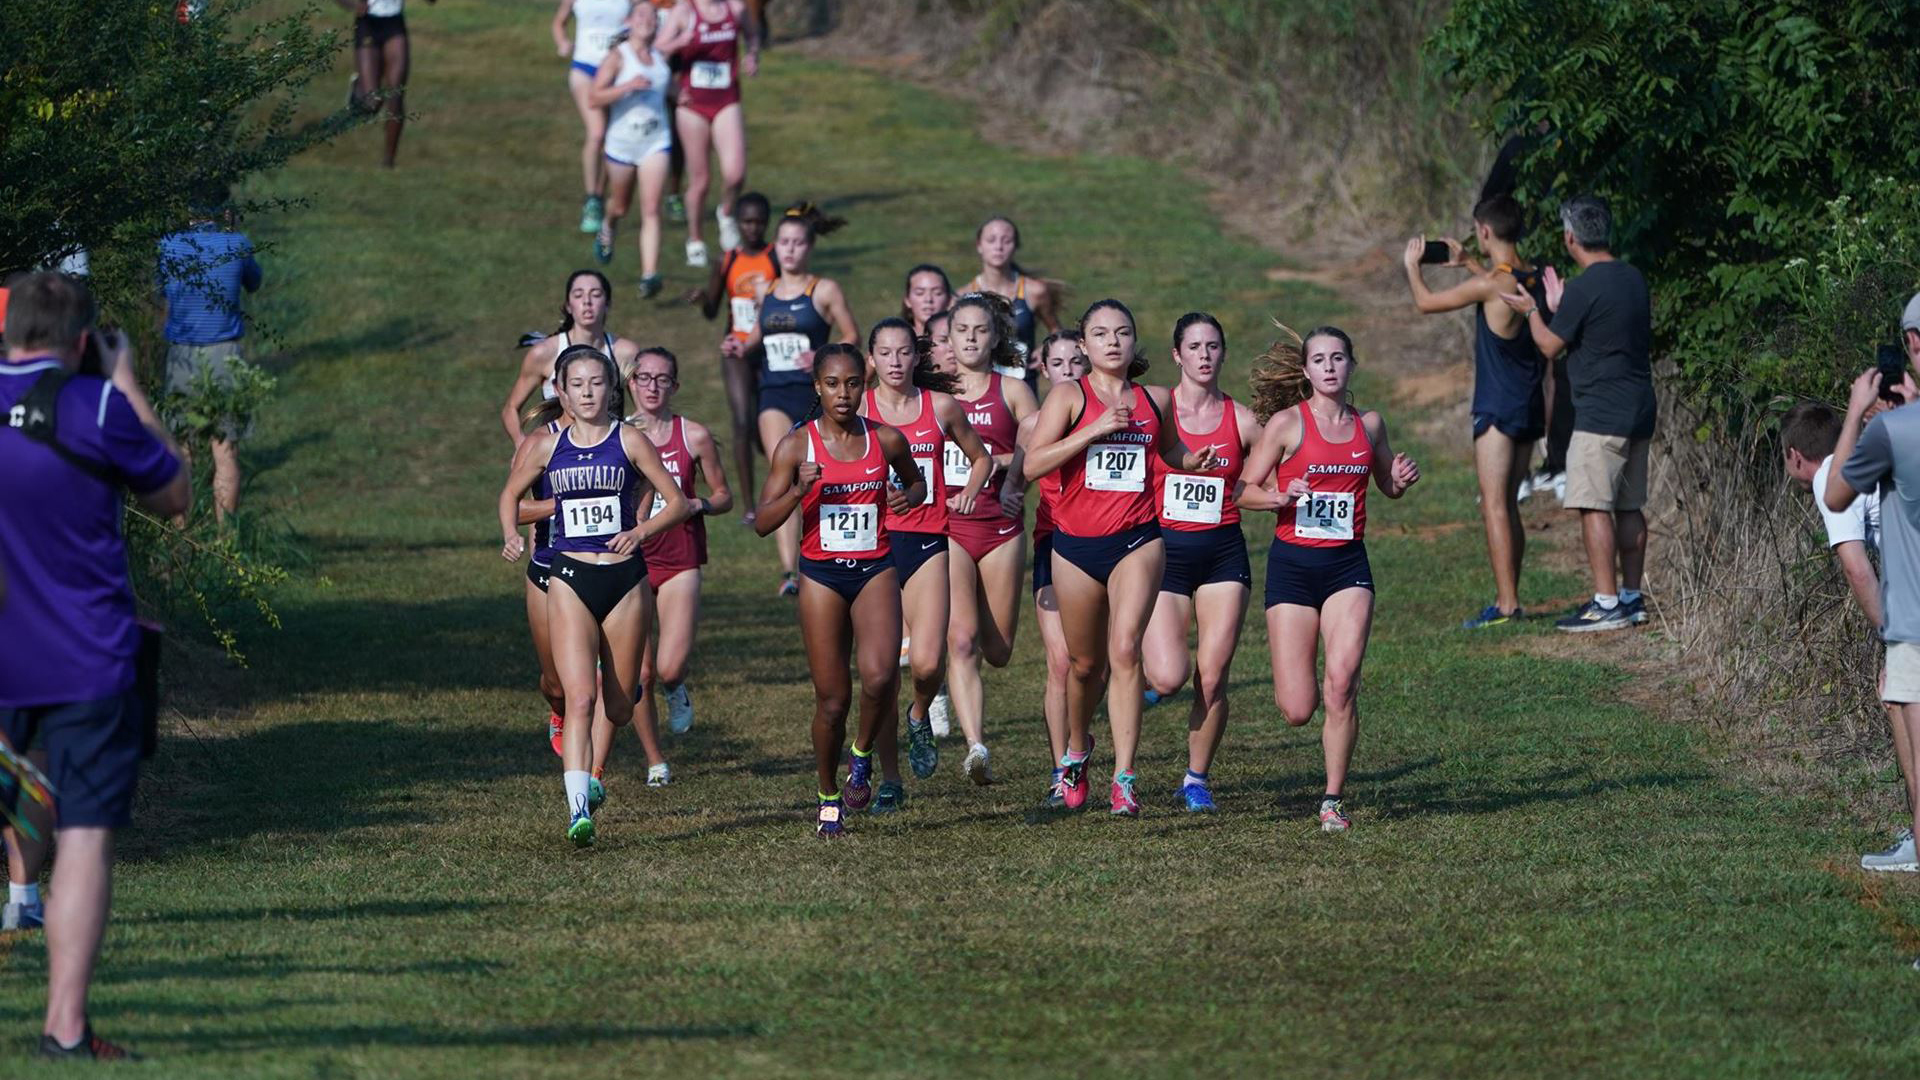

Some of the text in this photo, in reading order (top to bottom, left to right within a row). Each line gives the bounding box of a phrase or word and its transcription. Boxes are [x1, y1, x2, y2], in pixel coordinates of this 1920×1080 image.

[1095, 451, 1138, 471] 1207
[1308, 464, 1369, 474] SAMFORD
[823, 481, 883, 495] SAMFORD
[1173, 482, 1217, 503] 1209
[570, 504, 614, 526] 1194
[1306, 499, 1348, 519] 1213
[828, 512, 869, 531] 1211
